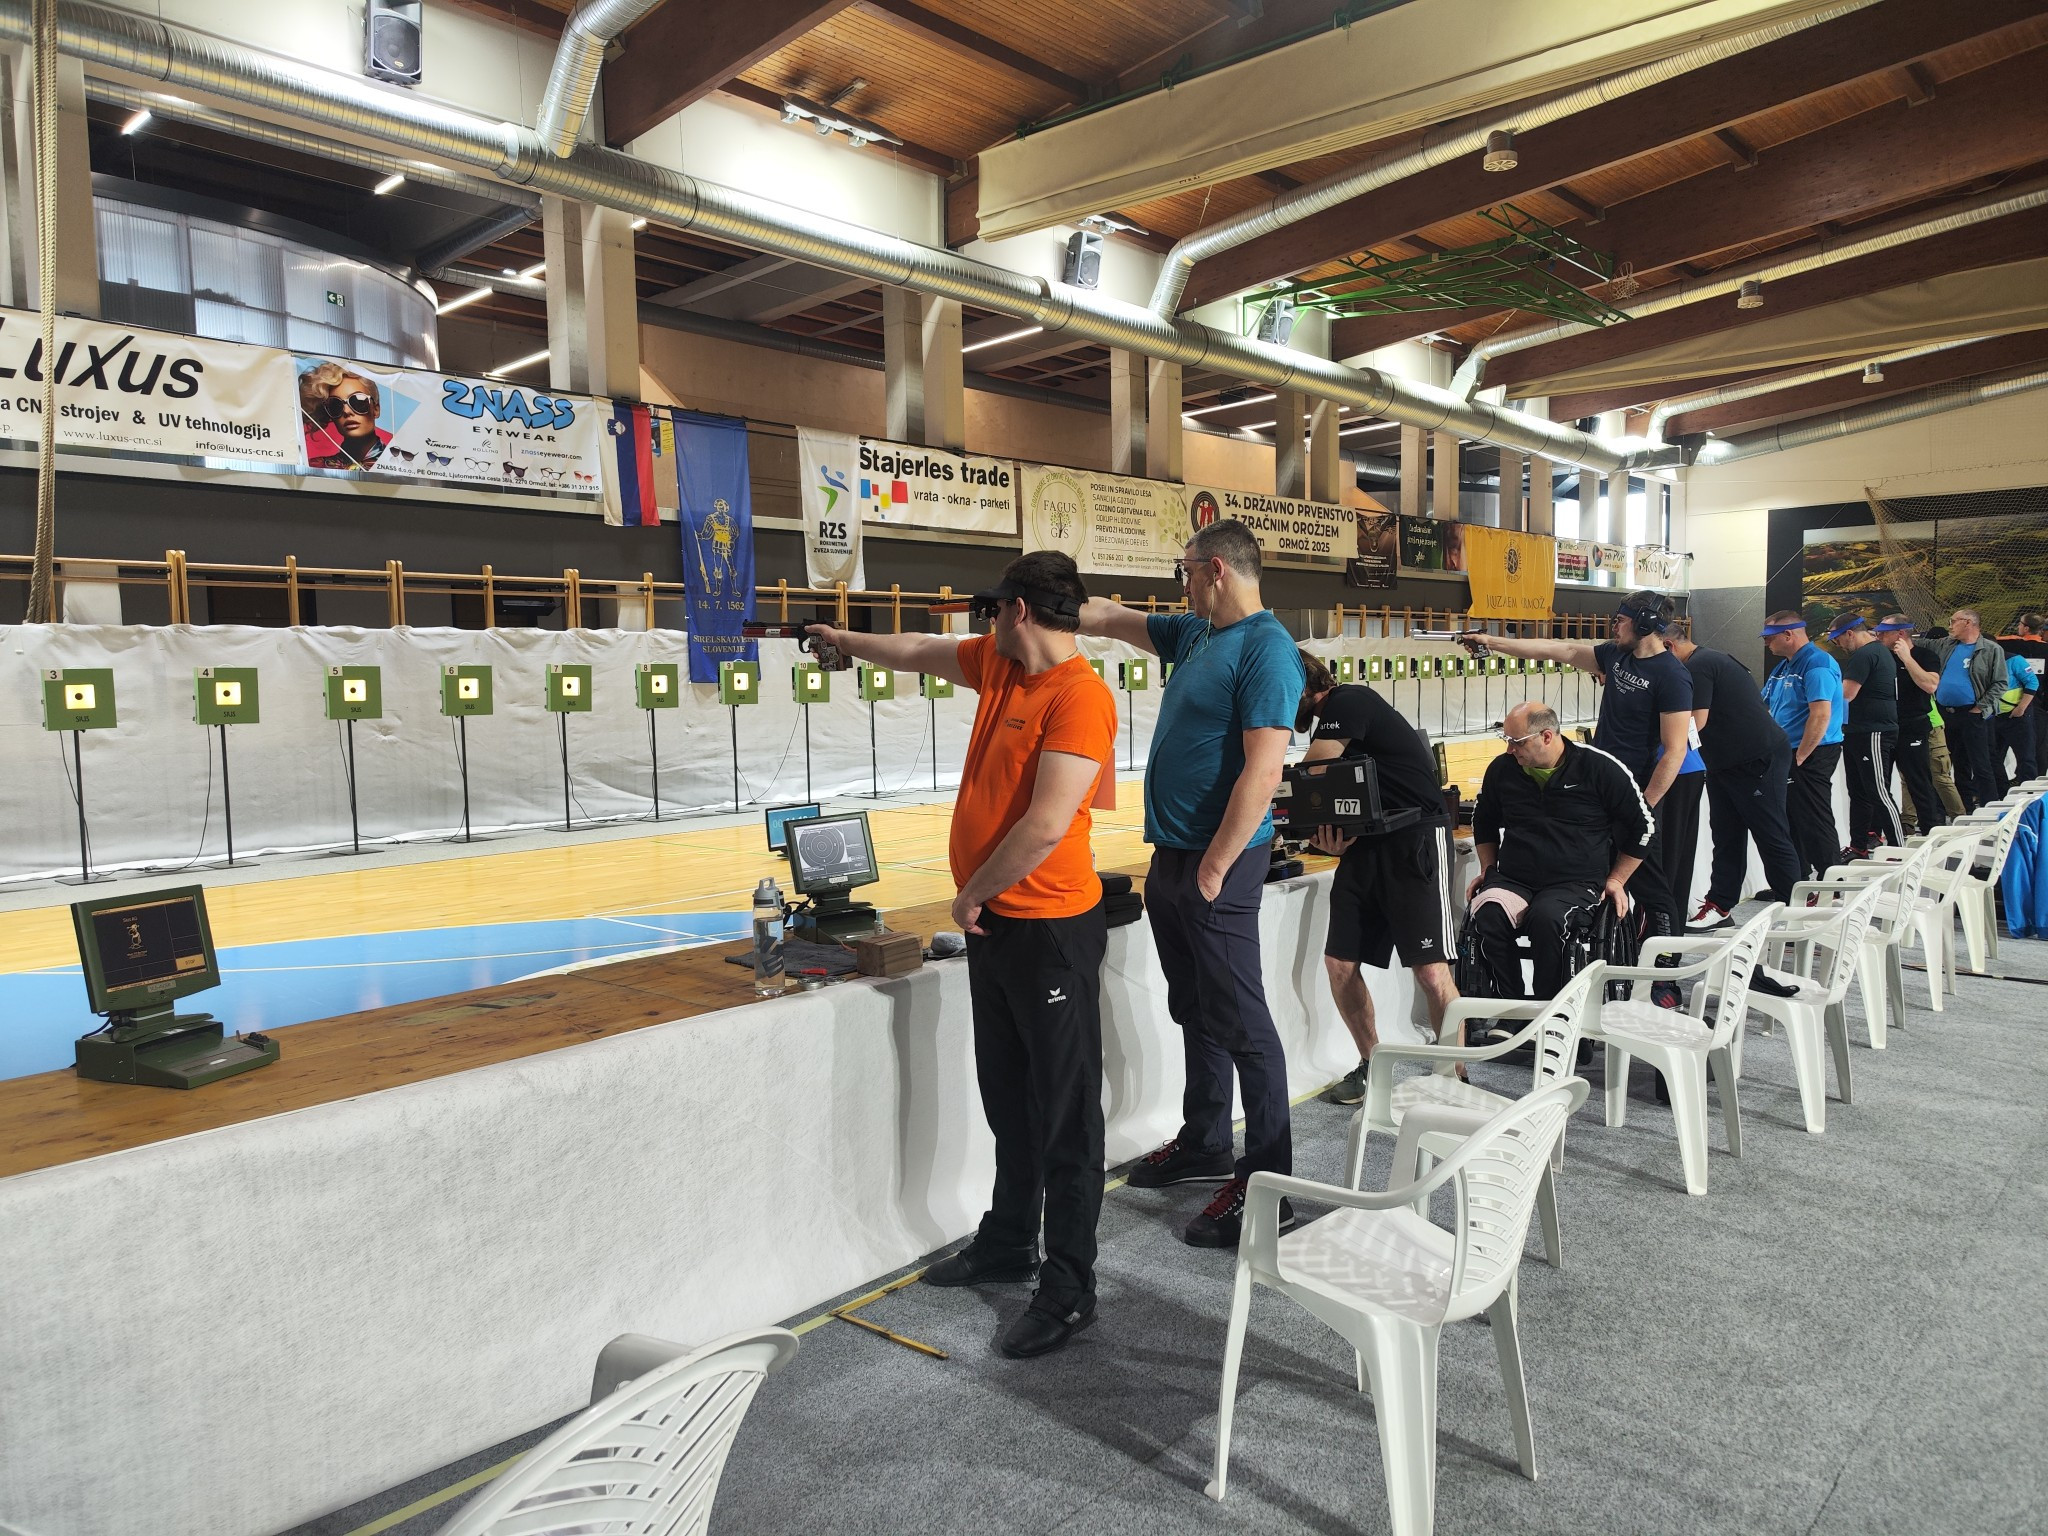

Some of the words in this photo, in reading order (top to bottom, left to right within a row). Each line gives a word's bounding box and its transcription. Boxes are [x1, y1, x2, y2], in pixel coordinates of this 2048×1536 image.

[442, 379, 576, 431] ZNASS
[60, 403, 120, 423] strojev
[132, 410, 146, 425] &
[159, 413, 182, 428] UV
[186, 415, 271, 440] tehnologija
[63, 429, 163, 447] www.luxus-cnc.si
[472, 425, 557, 443] EYEWEAR
[195, 440, 284, 458] info@luxus-cnc.si
[520, 448, 583, 461] znasseyewear.com
[859, 440, 954, 480] Štajerles
[960, 461, 1010, 488] trade
[913, 490, 939, 502] vrata
[947, 493, 971, 507] okna
[980, 498, 1010, 510] parketi
[1043, 500, 1077, 514] FAGUS
[1224, 493, 1242, 509] 34.
[1243, 495, 1295, 516] DRŽAVNO
[1297, 504, 1354, 523] PRVENSTVO
[819, 520, 847, 540] RZS
[1241, 513, 1290, 533] ZRAČNIM
[1292, 520, 1339, 539] OROŽJEM
[1279, 537, 1310, 551] ORMOŽ
[1311, 541, 1330, 553] 2025
[697, 600, 711, 610] 14.
[715, 601, 723, 610] 7.
[726, 601, 745, 611] 1562
[702, 645, 746, 653] SLOVENIJE
[50, 670, 57, 680] 3
[202, 668, 209, 677] 4
[333, 667, 339, 675] 5
[449, 667, 454, 675] 6
[1623, 671, 1650, 689] TAILOR
[1336, 801, 1358, 813] 707
